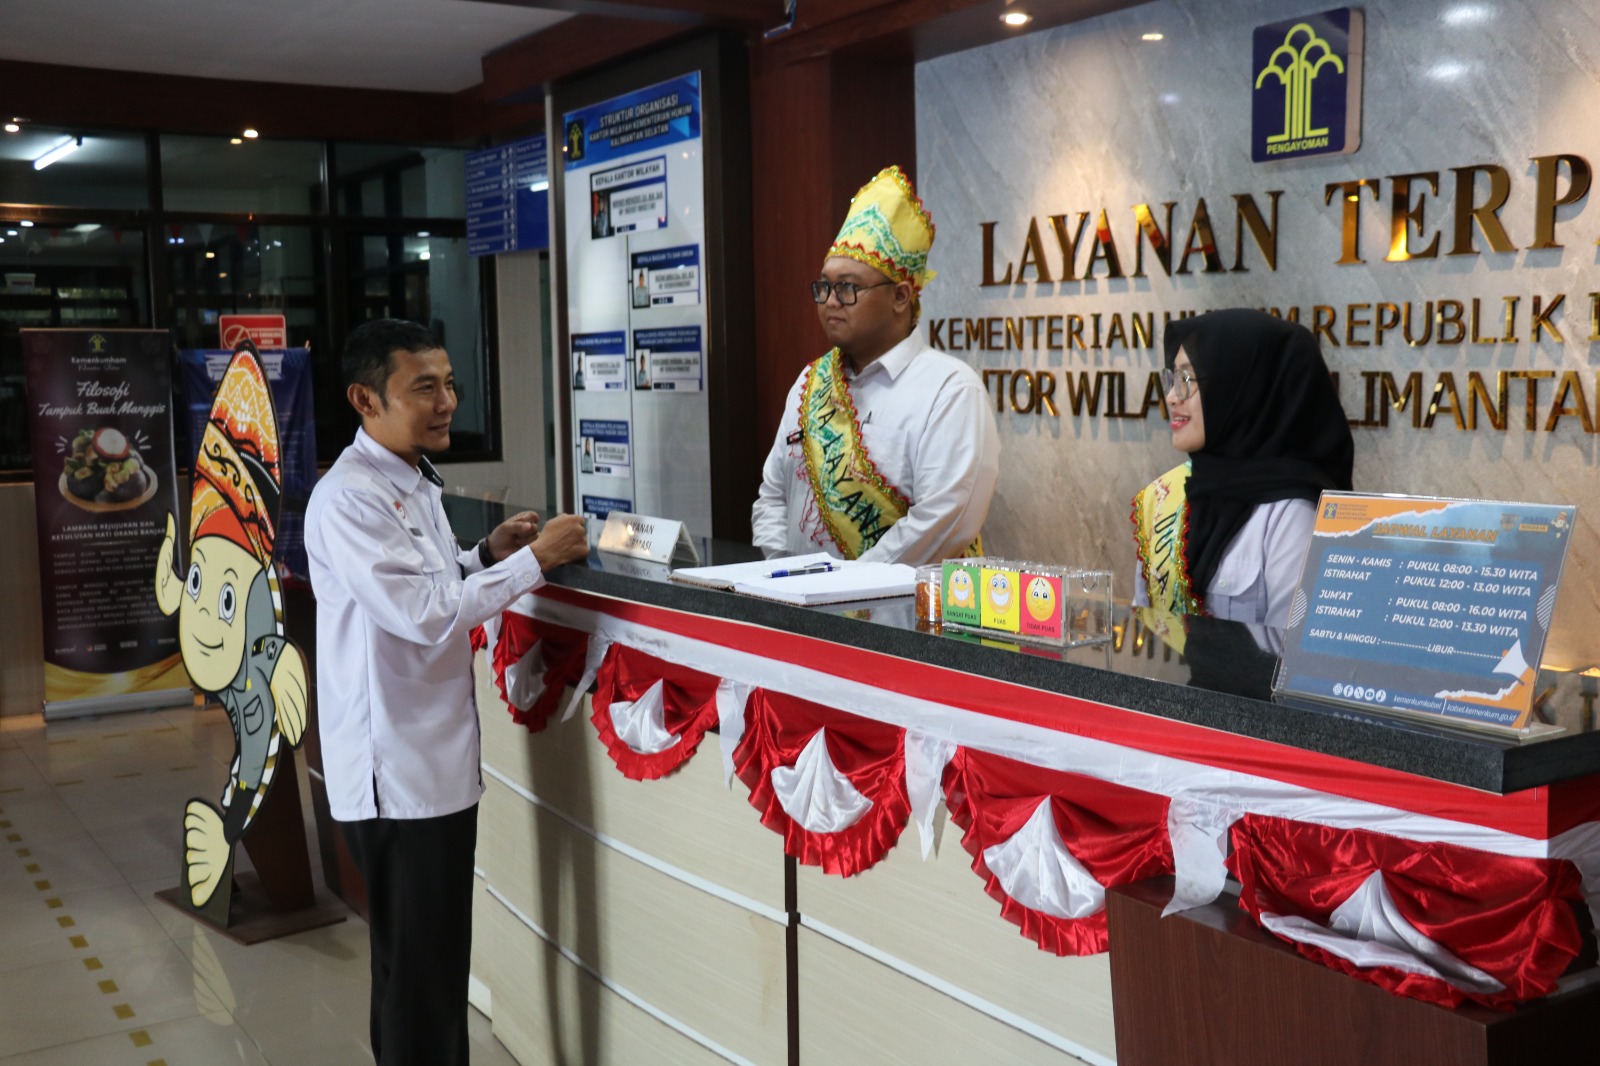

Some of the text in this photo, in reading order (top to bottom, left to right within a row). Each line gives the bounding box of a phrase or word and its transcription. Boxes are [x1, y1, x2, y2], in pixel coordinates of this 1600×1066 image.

[600, 93, 679, 128] STRUKTUR ORGANISASI
[589, 104, 692, 142] KANTOR WILAYAH KEMENTERIAN HUKUM
[610, 124, 669, 147] KALIMANTAN SELATAN
[1266, 137, 1329, 155] PENGAYOMAN
[595, 164, 660, 186] KEPALA KANTOR WILAYAH
[978, 154, 1600, 287] LAYANAN TERP
[929, 312, 1154, 351] KEMENTERIAN
[1312, 294, 1566, 347] REPUBLIK
[71, 356, 127, 364] Kemenkumham
[76, 380, 130, 401] Filosofi
[1066, 370, 1169, 420] WILA
[38, 400, 166, 420] Tampuk Buah Manggis
[822, 433, 892, 548] LAYANA
[51, 532, 93, 541] KETULUSAN
[140, 528, 166, 536] BANJAR
[99, 522, 138, 531] KEJUJURAN
[1372, 522, 1499, 542] JADWAL LAYANAN
[1154, 511, 1178, 596] DUTA
[1327, 554, 1355, 564] SENIN
[1361, 557, 1392, 568] KAMIS
[1407, 560, 1440, 572] PUKUL
[1443, 563, 1472, 575] 08:00
[1481, 566, 1506, 577] 15.30
[1509, 569, 1538, 580] WITA
[1323, 568, 1371, 581] ISTIRAHAT
[1403, 575, 1436, 587] PUKUL
[1439, 578, 1464, 589] 12:00
[1473, 582, 1499, 593] 13.00
[1502, 585, 1531, 597] WITA
[1319, 589, 1353, 600] JUM'AT
[1395, 597, 1429, 609] PUKUL
[1432, 601, 1460, 612] 08:00
[1469, 605, 1495, 616] 16.00
[1498, 608, 1527, 620] WITA
[993, 617, 1006, 625] PUAS
[1041, 625, 1055, 633] PUAS
[1315, 605, 1363, 618] ISTIRAHAT
[1391, 613, 1425, 626] PUKUL
[1428, 618, 1453, 629] 12:00
[1461, 621, 1487, 633] 13.30
[1489, 625, 1519, 637] WITA
[1309, 628, 1336, 639] SABTU
[1336, 632, 1342, 640] &
[1343, 633, 1376, 644] MINGGU
